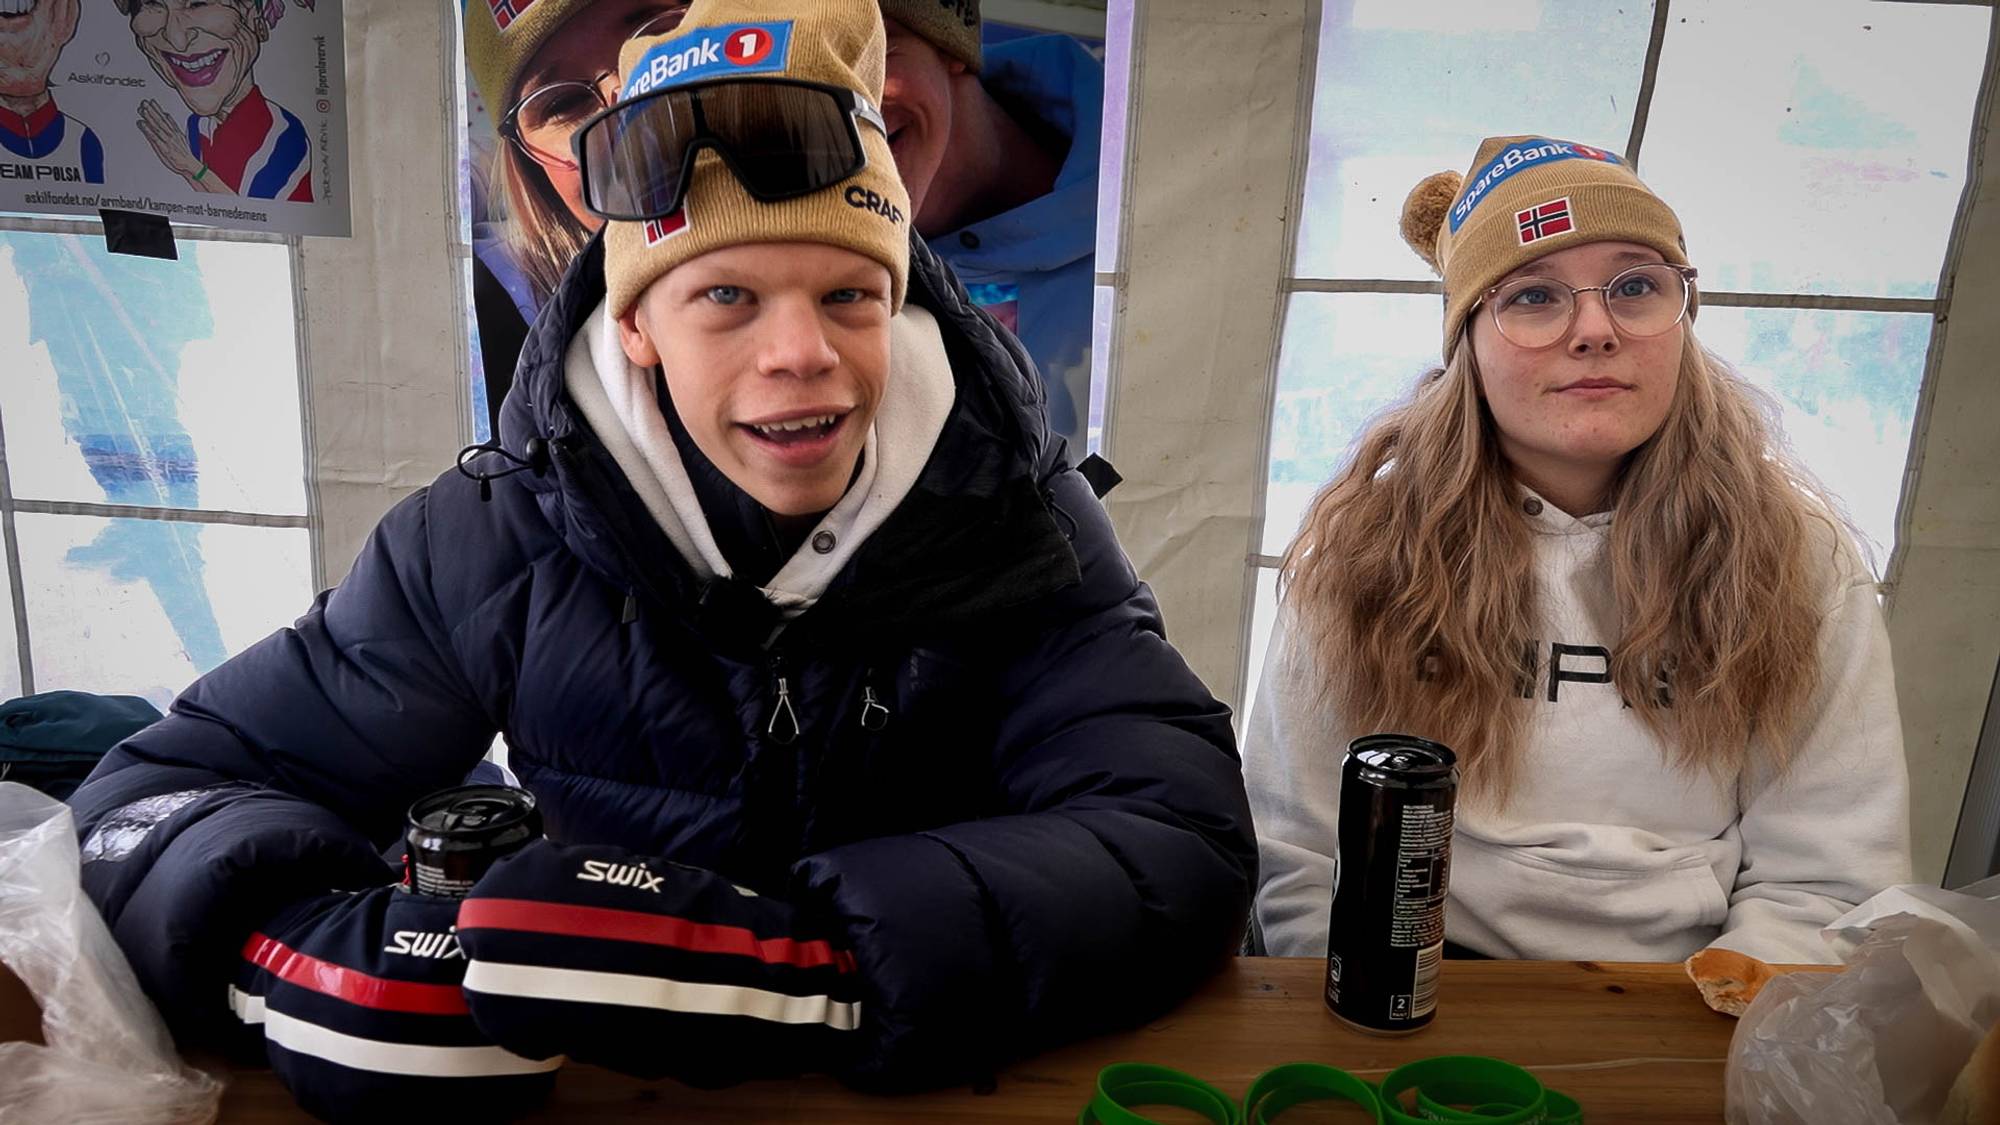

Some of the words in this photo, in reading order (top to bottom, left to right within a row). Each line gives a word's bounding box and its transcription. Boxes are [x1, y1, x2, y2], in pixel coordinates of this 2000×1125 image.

[739, 33, 757, 58] 1
[67, 72, 146, 88] Askilfondet
[0, 163, 34, 180] EAM
[1454, 142, 1573, 223] SpareBank
[1396, 998, 1406, 1009] 2
